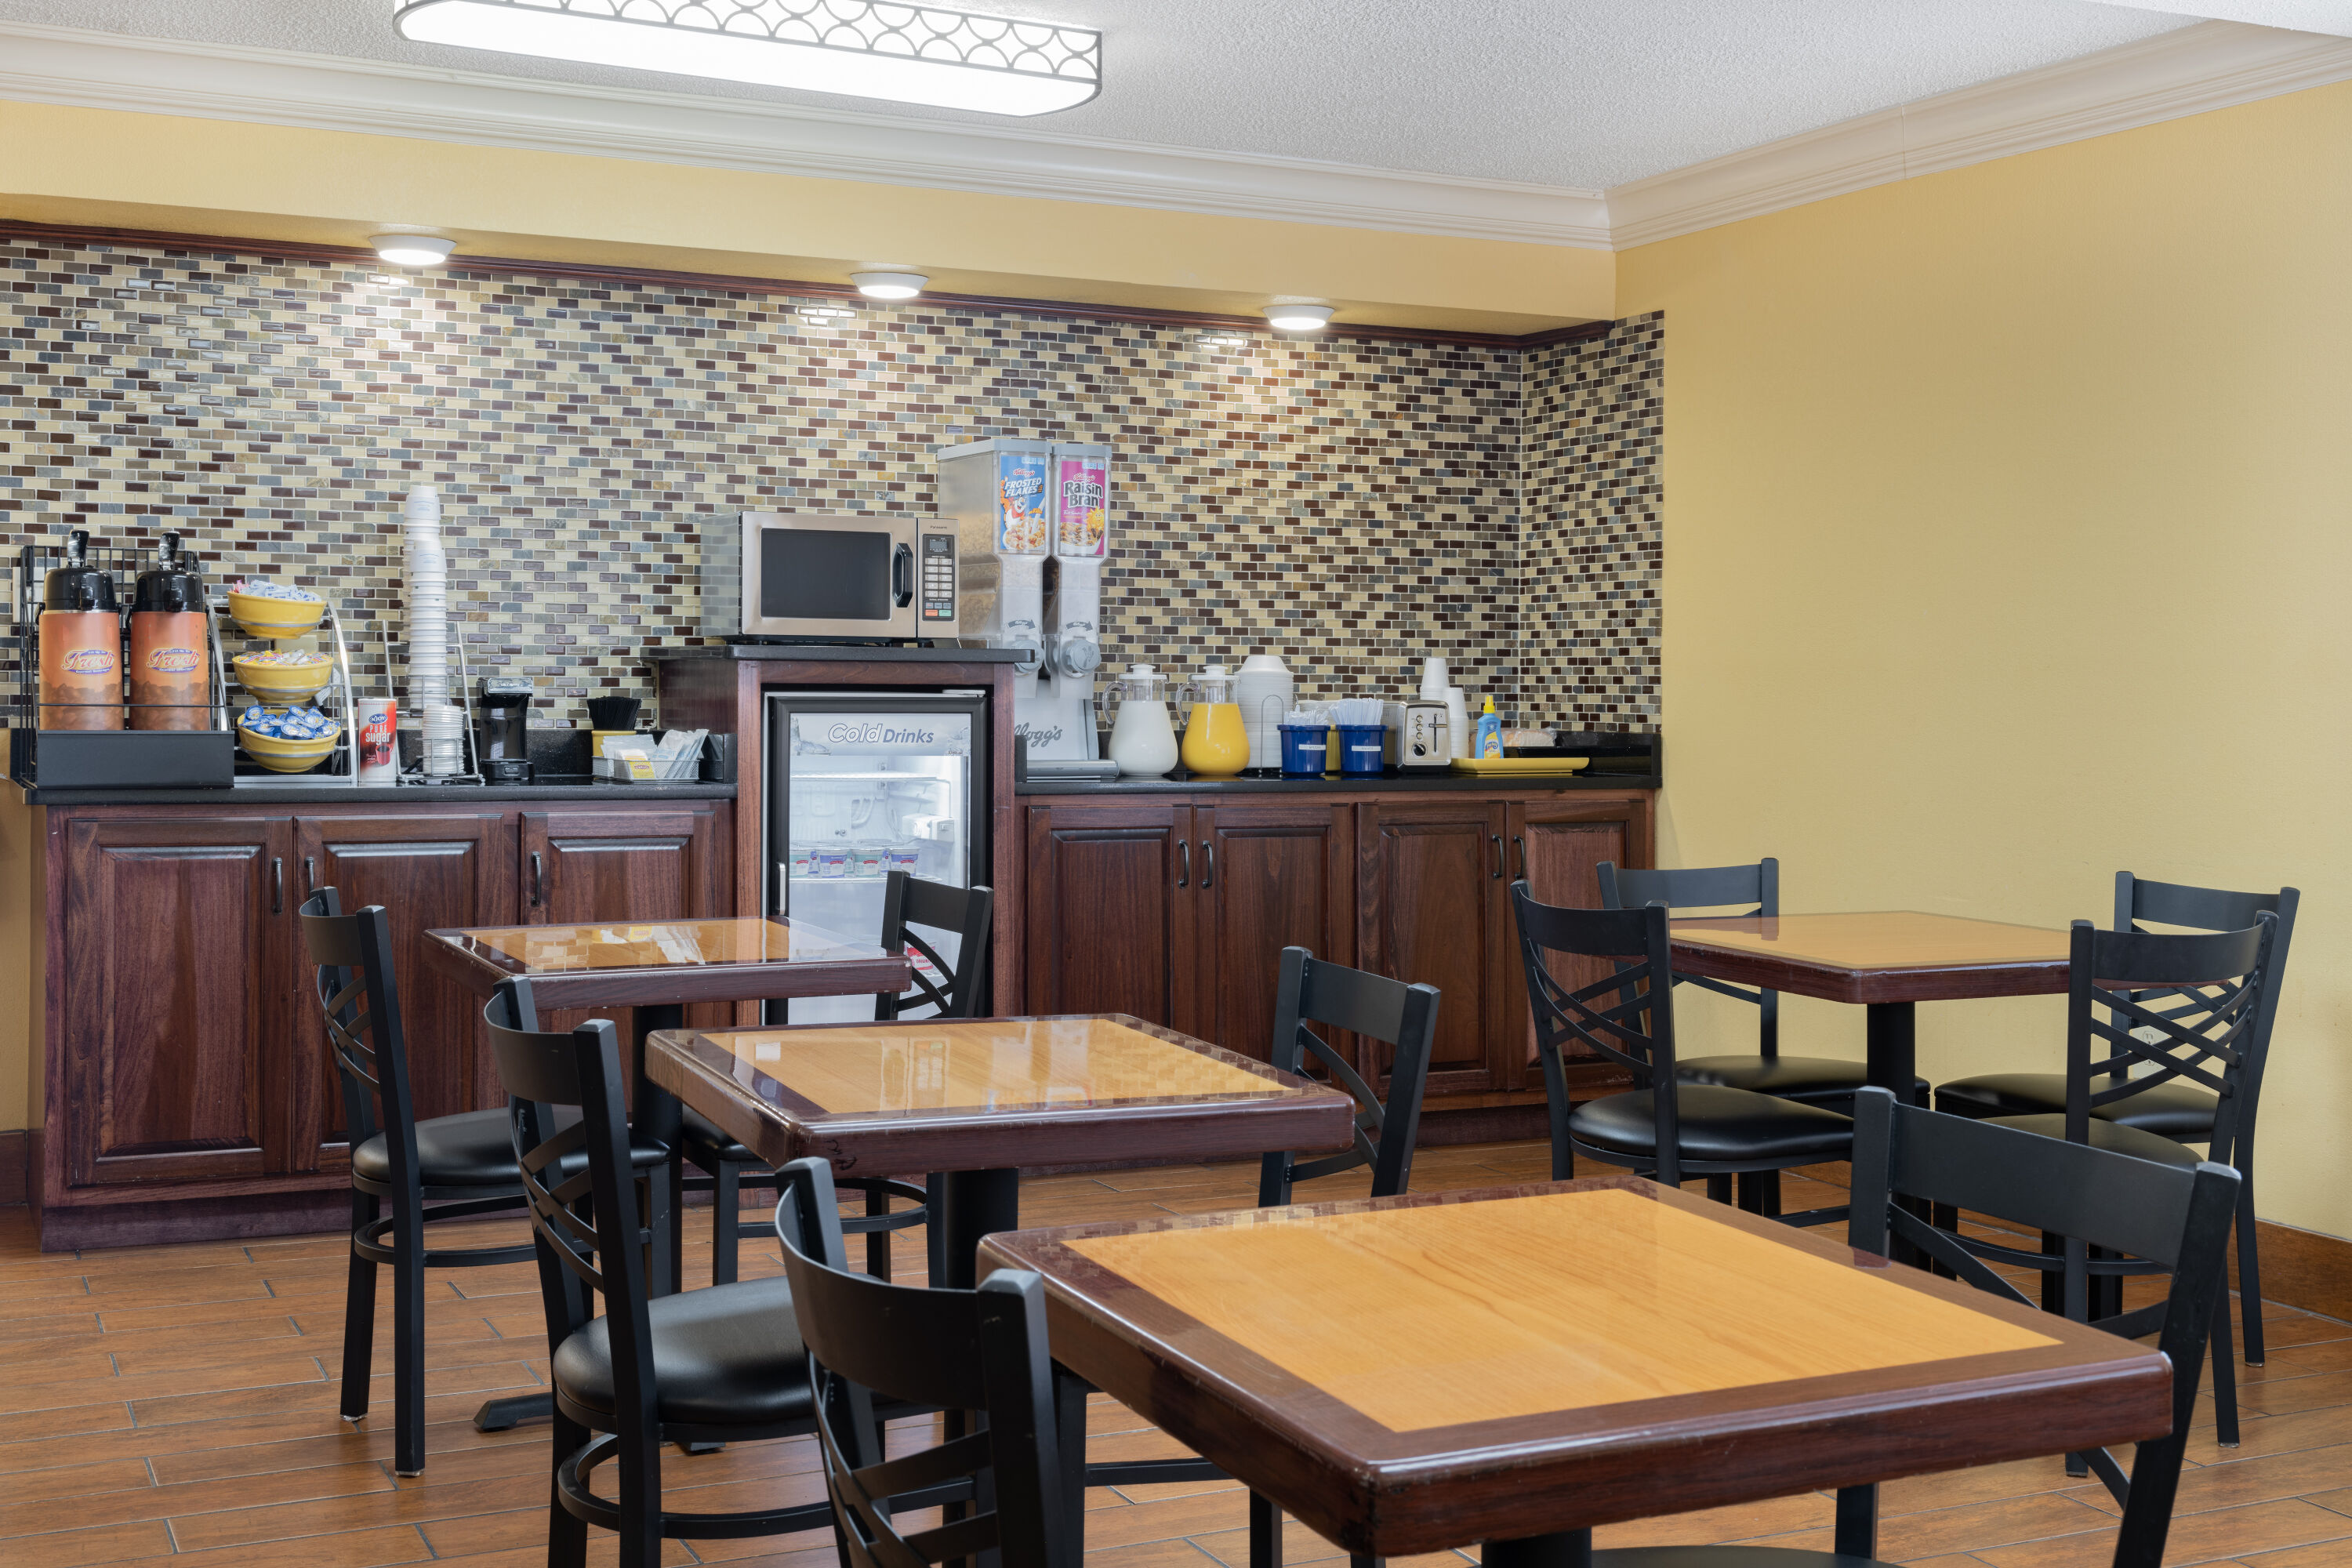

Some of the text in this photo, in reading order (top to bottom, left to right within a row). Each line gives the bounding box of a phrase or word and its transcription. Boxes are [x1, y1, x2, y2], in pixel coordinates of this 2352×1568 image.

[1005, 477, 1042, 489] FROSTED
[1064, 481, 1103, 498] Raisin
[1005, 485, 1037, 497] FLAKES
[1069, 494, 1099, 508] Bran
[61, 650, 114, 670] Fresh
[147, 648, 200, 667] Fresh
[365, 732, 391, 746] sugar
[829, 724, 935, 743] Cold Drinks
